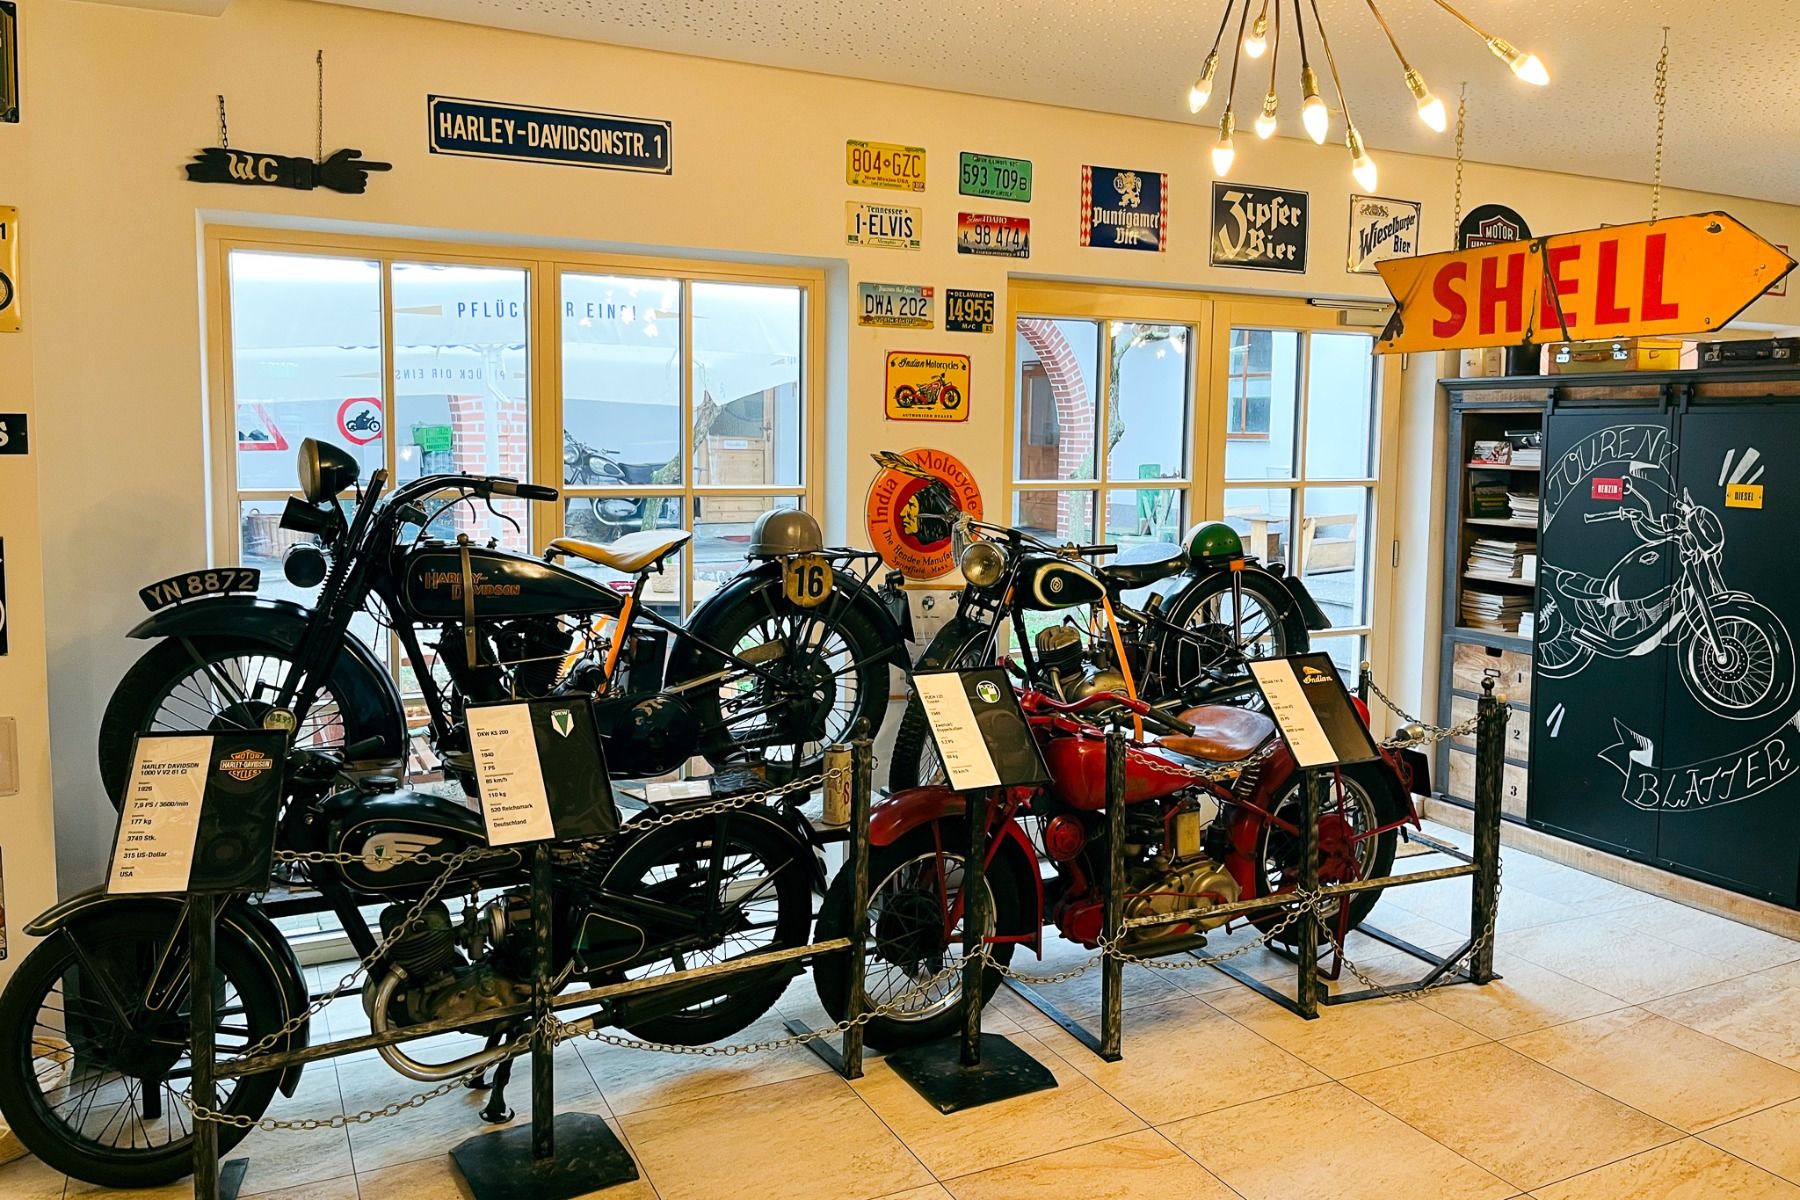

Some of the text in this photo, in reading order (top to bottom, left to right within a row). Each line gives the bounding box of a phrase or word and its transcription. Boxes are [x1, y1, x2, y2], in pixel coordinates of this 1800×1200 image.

[439, 112, 662, 159] HARLEY-DAVIDSONSTR. 1
[226, 152, 278, 182] WC
[853, 148, 921, 178] 804 GZC
[963, 163, 987, 186] 593
[994, 167, 1018, 190] 709
[866, 205, 903, 215] Tennessee
[984, 215, 1008, 224] IDAHO
[1092, 206, 1160, 229] Puntigamer
[856, 213, 913, 238] 1-ELVIS
[1219, 190, 1302, 259] Zipfer
[1485, 222, 1514, 240] MOTOR
[975, 224, 991, 245] 98
[996, 226, 1020, 248] 474
[1246, 228, 1297, 261] Bier
[1393, 234, 1411, 254] Bier
[954, 291, 987, 299] DELAWARE
[1432, 233, 1679, 339] SHELL
[457, 299, 526, 318] PFLÜC
[865, 294, 927, 317] DWA 202
[948, 298, 993, 323] 14955
[898, 357, 959, 372] Indian Motorcycles
[1548, 427, 1667, 505] TOUREN
[1734, 491, 1754, 501] DIESEL
[147, 571, 254, 605] YN 8872
[452, 584, 520, 600] DVIDSON
[794, 565, 824, 598] 16
[1517, 672, 1522, 683] 1
[1513, 729, 1521, 740] 2
[232, 769, 258, 779] CYCLES
[1510, 785, 1518, 797] 3
[143, 818, 152, 826] kg
[493, 818, 527, 828] Deutschland
